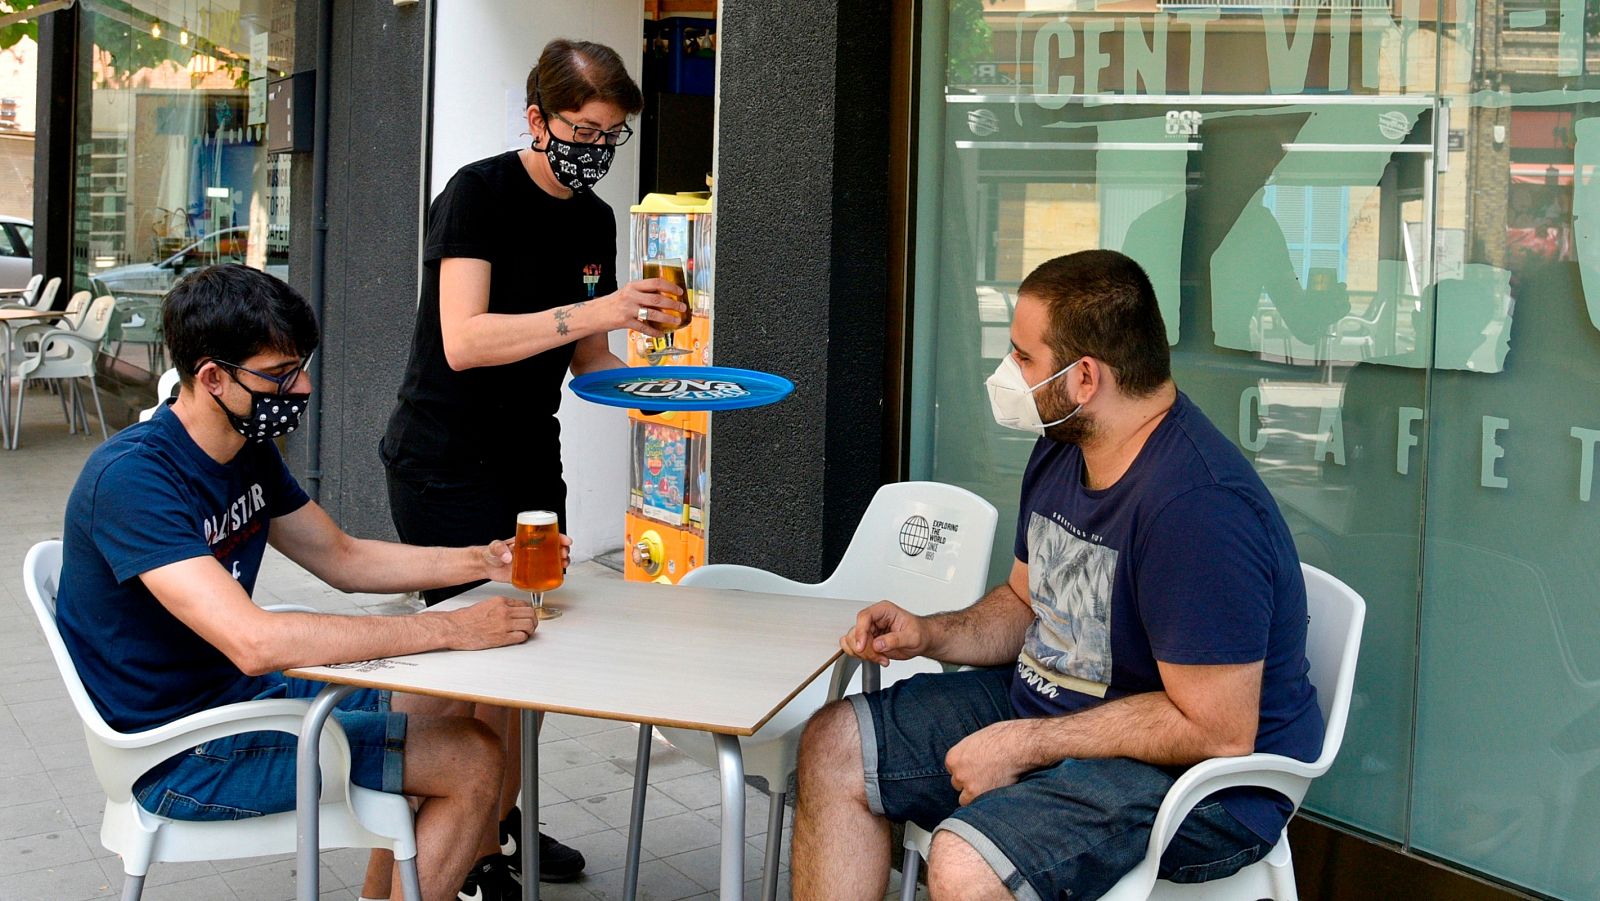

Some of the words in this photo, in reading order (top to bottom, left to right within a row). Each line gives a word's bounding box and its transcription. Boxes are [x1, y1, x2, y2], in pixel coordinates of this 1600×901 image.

[1033, 8, 1220, 109] CENT
[582, 168, 597, 178] 123
[932, 519, 959, 532] EXPLORING
[931, 527, 941, 536] THE
[929, 534, 947, 545] WORLD
